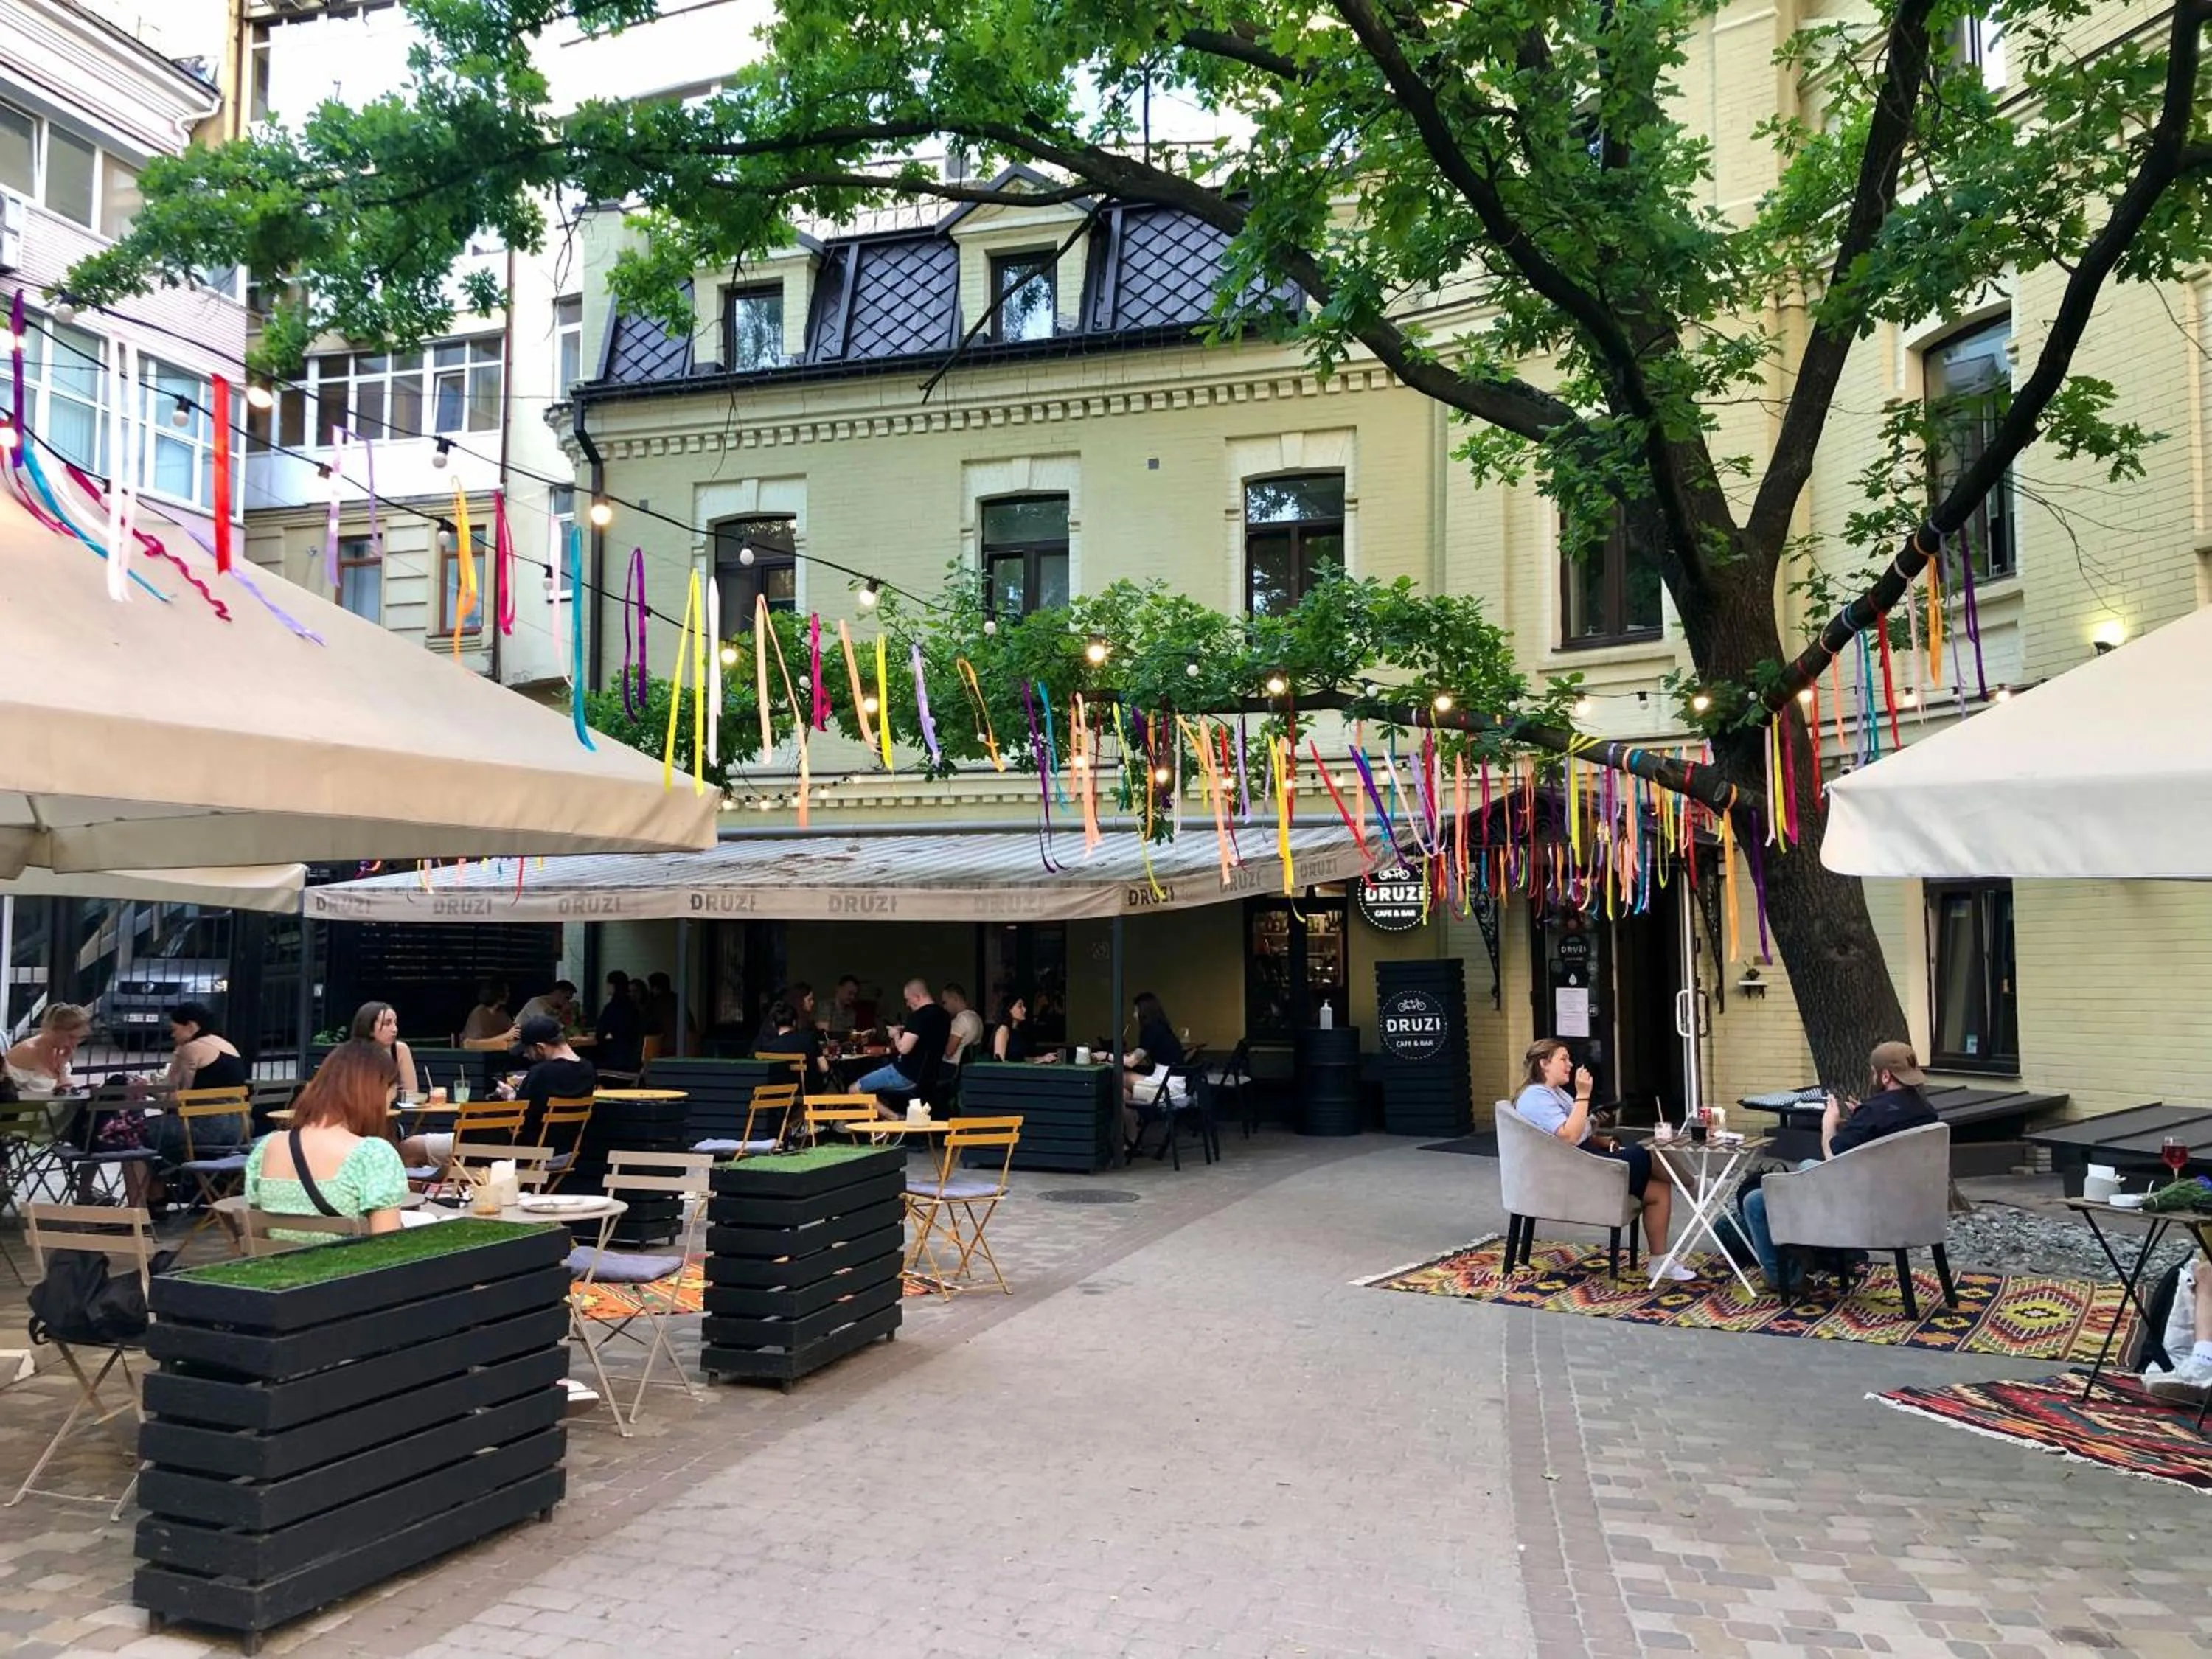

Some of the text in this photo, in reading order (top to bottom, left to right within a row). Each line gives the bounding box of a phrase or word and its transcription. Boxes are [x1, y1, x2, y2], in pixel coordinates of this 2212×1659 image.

[1365, 886, 1425, 901] DRUZI
[433, 897, 493, 915] DRUZI
[558, 896, 622, 914] DRUZI
[690, 894, 756, 913] DRUZI
[828, 894, 897, 914] DRUZI
[1386, 1018, 1440, 1032] DRUZI
